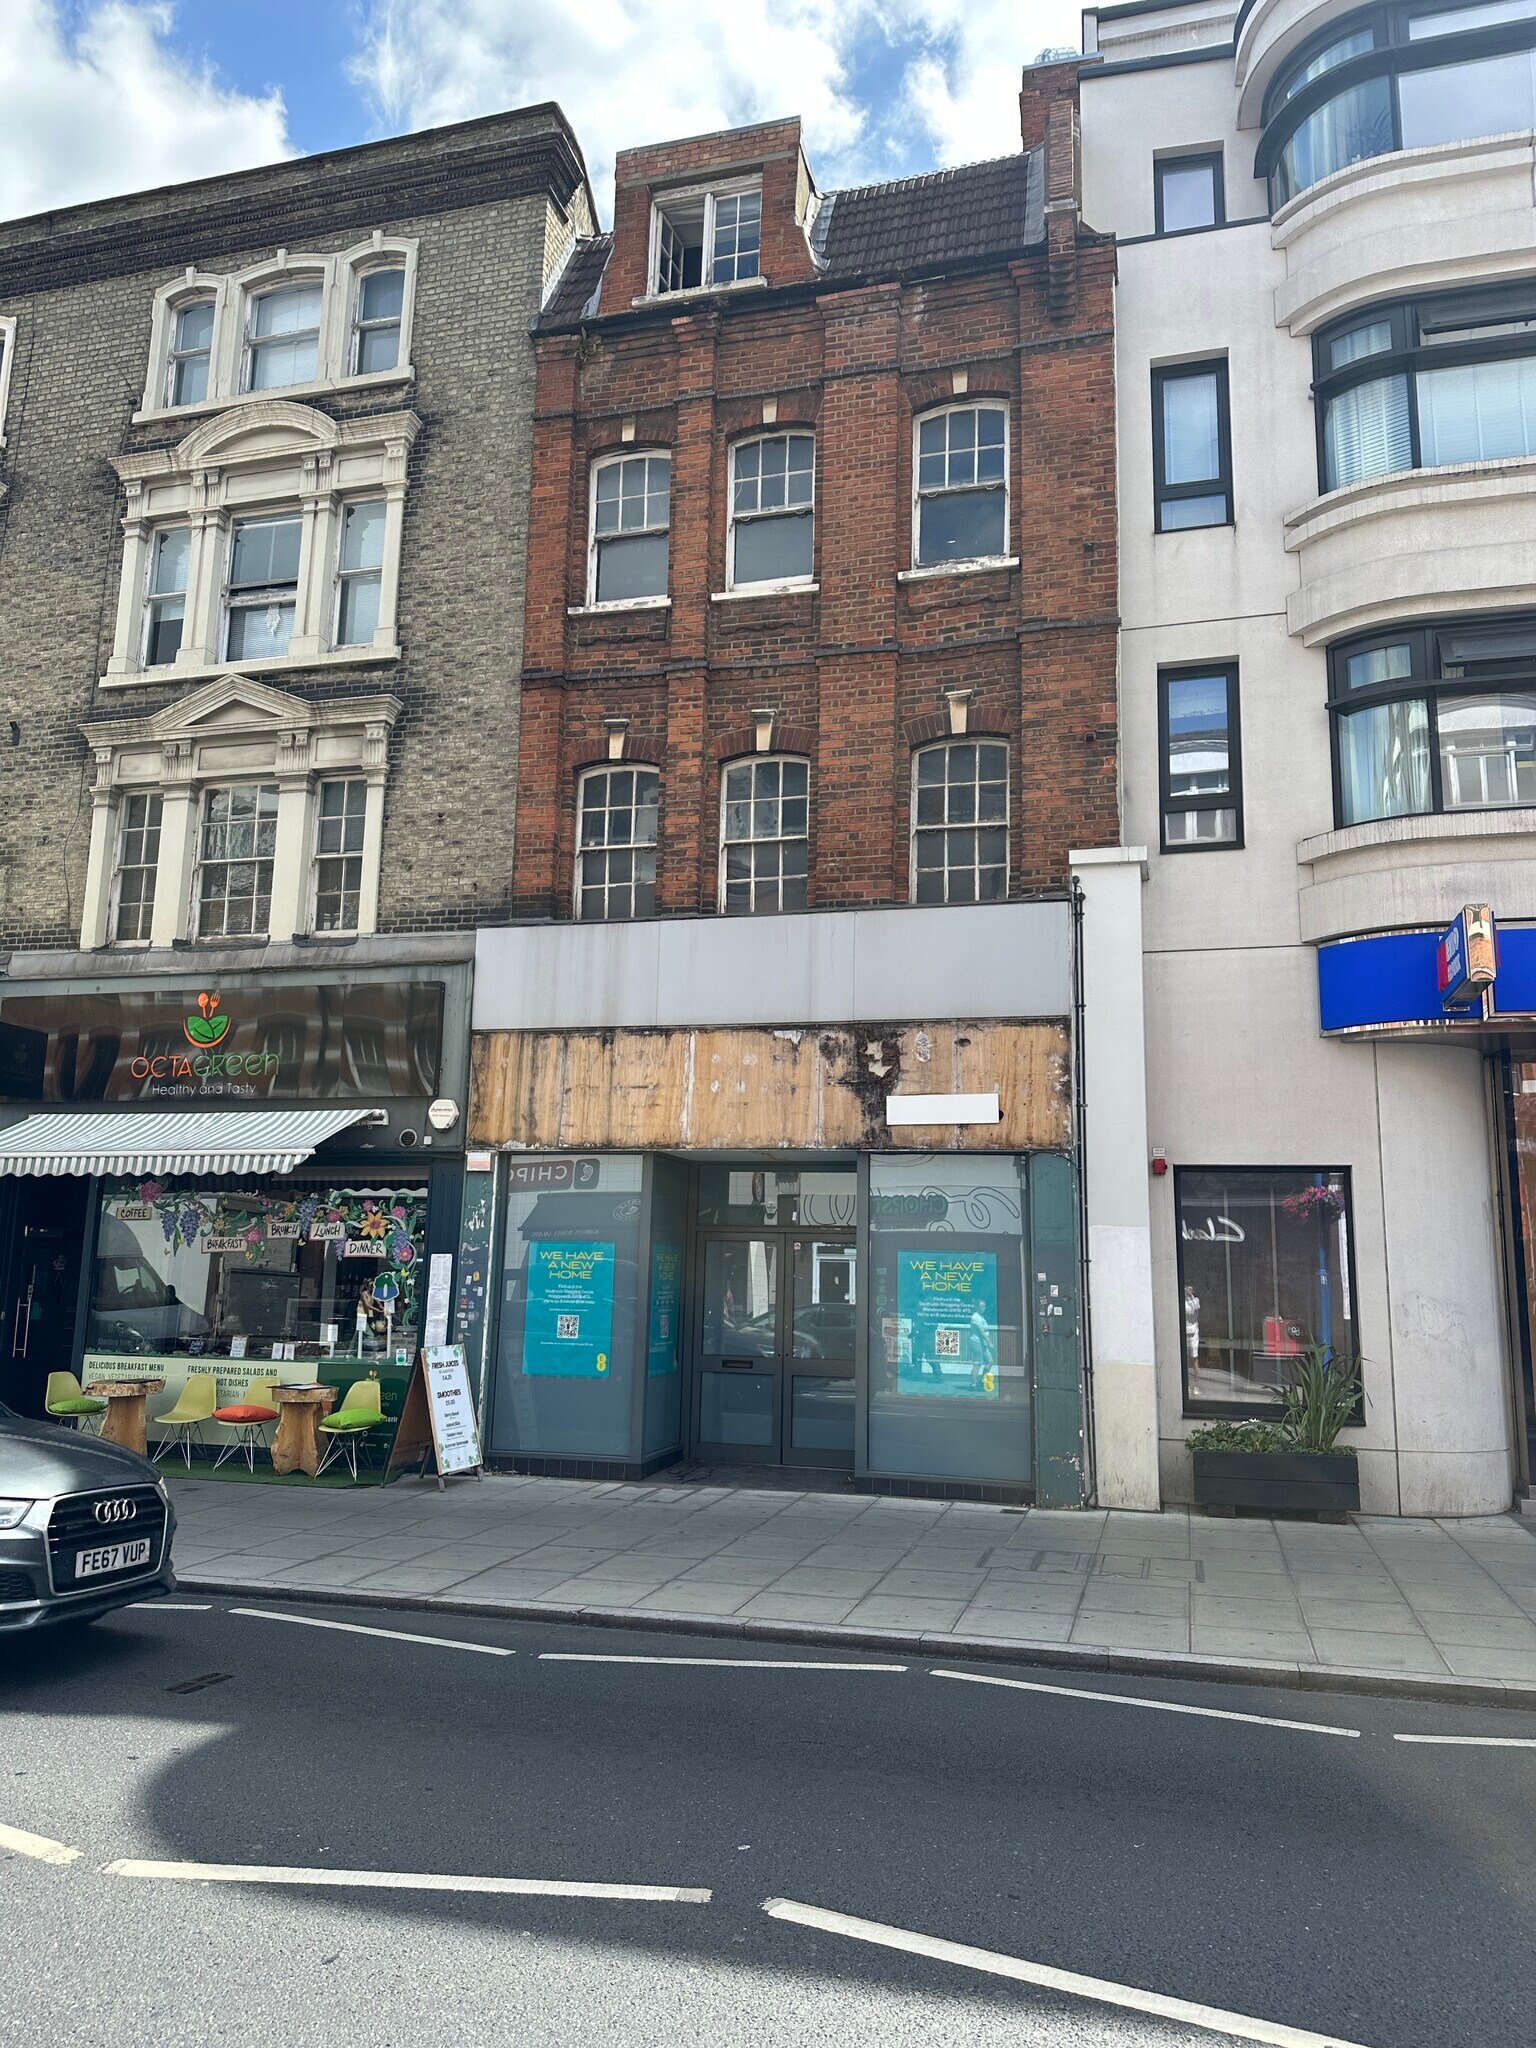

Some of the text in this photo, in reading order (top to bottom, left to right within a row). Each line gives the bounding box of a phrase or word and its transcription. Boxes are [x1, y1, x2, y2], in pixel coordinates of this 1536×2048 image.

[152, 1082, 257, 1098] Healthy and Tasty
[120, 1208, 148, 1218] COFFEE
[271, 1224, 299, 1236] BRUNCH
[313, 1224, 341, 1238] LUNCH
[207, 1238, 243, 1250] BREAKFAST
[540, 1251, 604, 1261] WE HAVE
[548, 1261, 594, 1270] A NEW
[910, 1260, 984, 1272] WE HAVE
[549, 1270, 592, 1280] HOME
[920, 1271, 974, 1282] A NEW
[922, 1282, 972, 1292] HOME
[88, 1361, 165, 1372] DELICIOUS BREAKFAST MENU
[187, 1366, 278, 1377] FRESHLY PREPARED SALADS AND
[228, 1379, 249, 1387] DISHES
[82, 1542, 146, 1573] FE67 VUP
